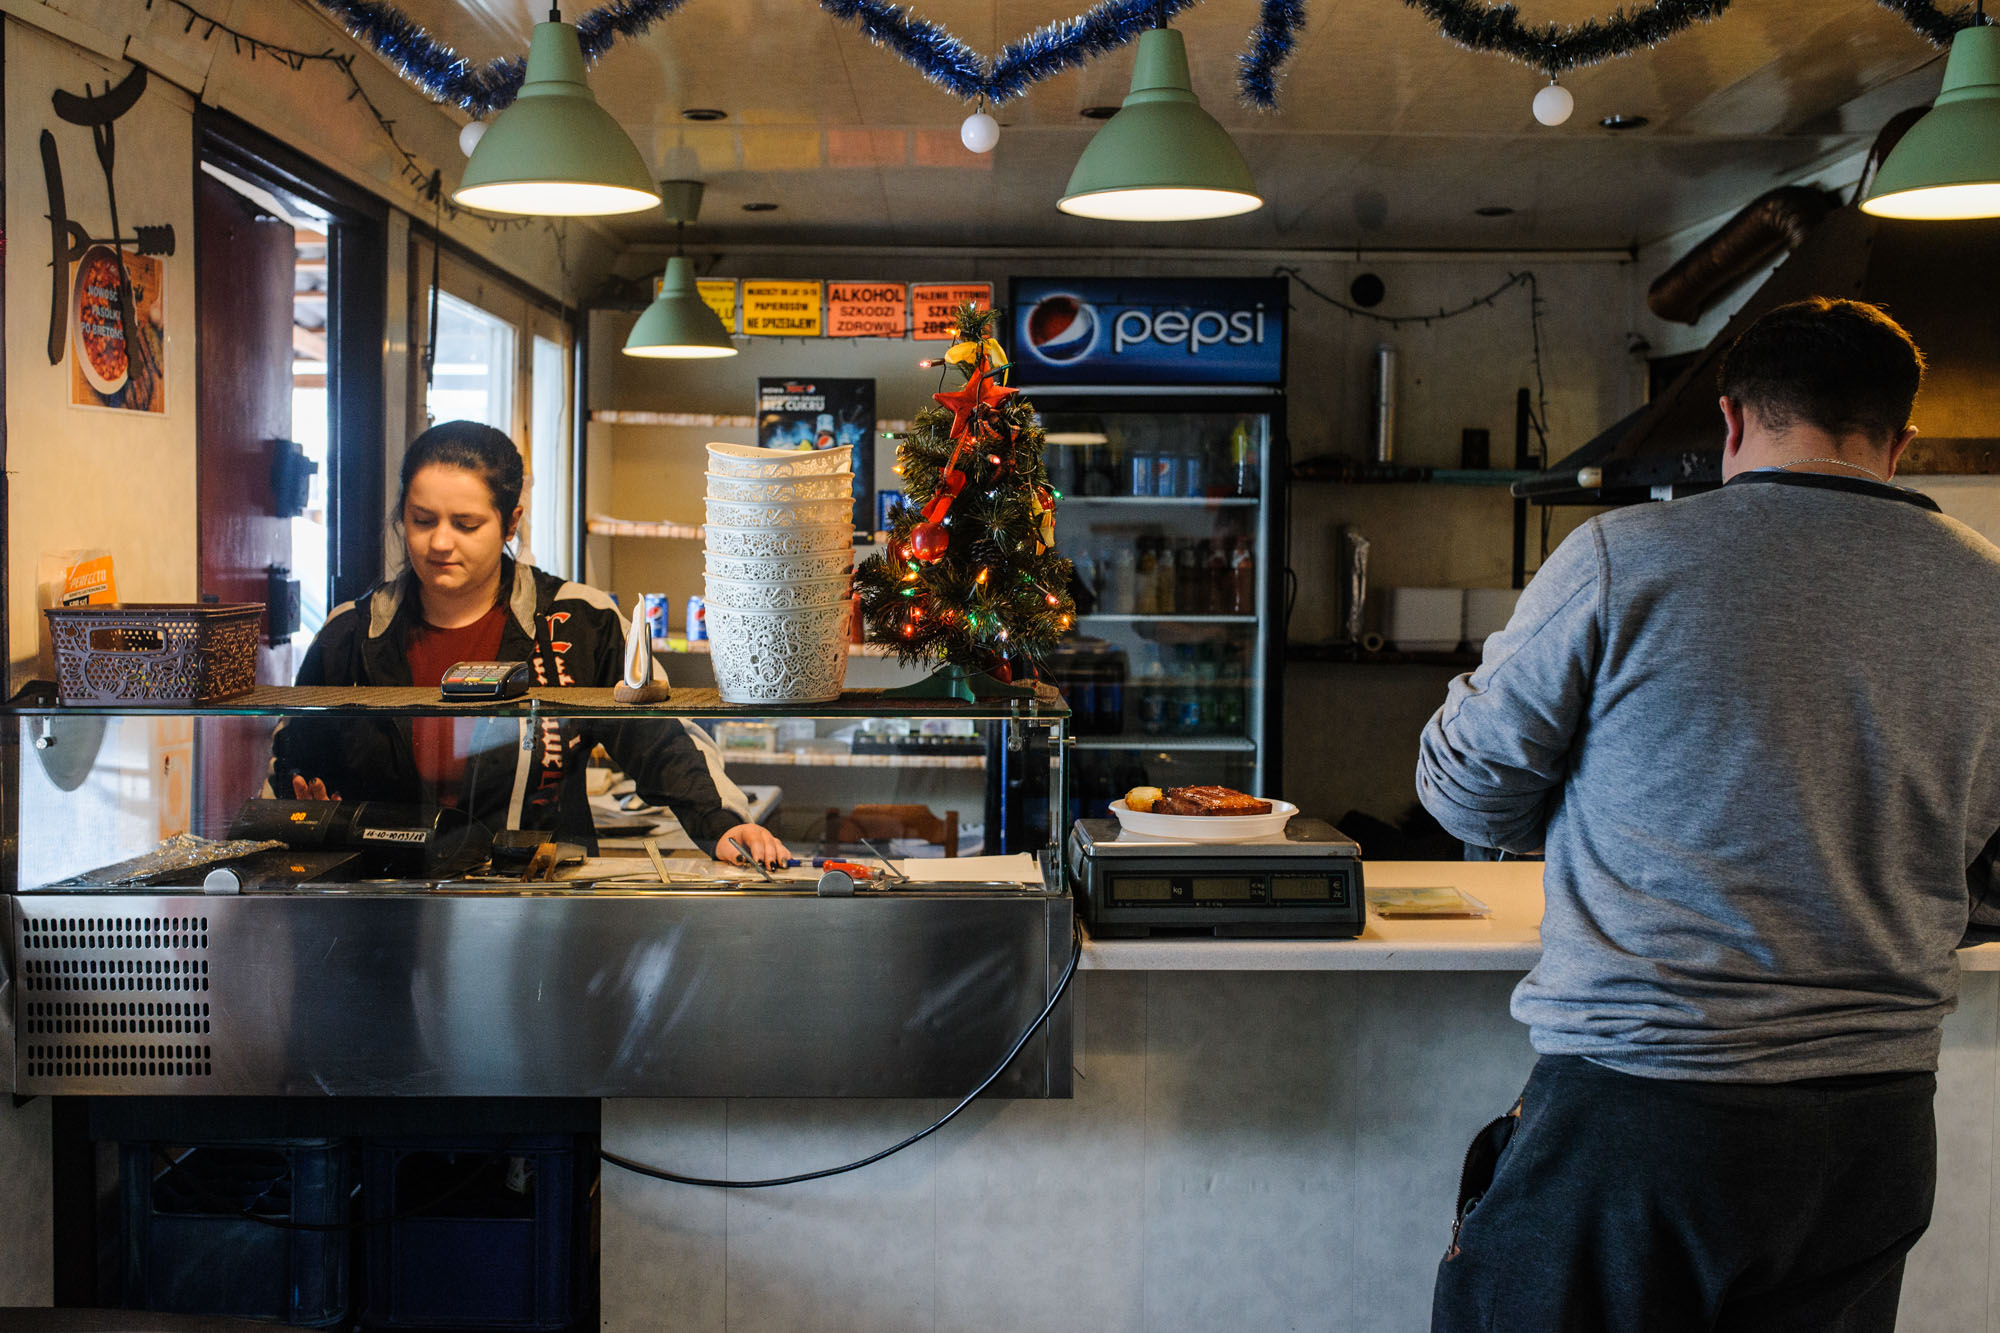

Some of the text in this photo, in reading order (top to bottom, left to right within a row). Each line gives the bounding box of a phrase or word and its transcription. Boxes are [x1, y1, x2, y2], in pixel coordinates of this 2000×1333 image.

[831, 288, 904, 303] ALKOHOL
[839, 306, 895, 317] SZKODZI
[837, 321, 898, 333] ZDROWIU
[1114, 302, 1266, 353] pepsi
[761, 400, 826, 411] BEZ CUKRU
[290, 811, 307, 821] 100
[1172, 885, 1183, 895] kg
